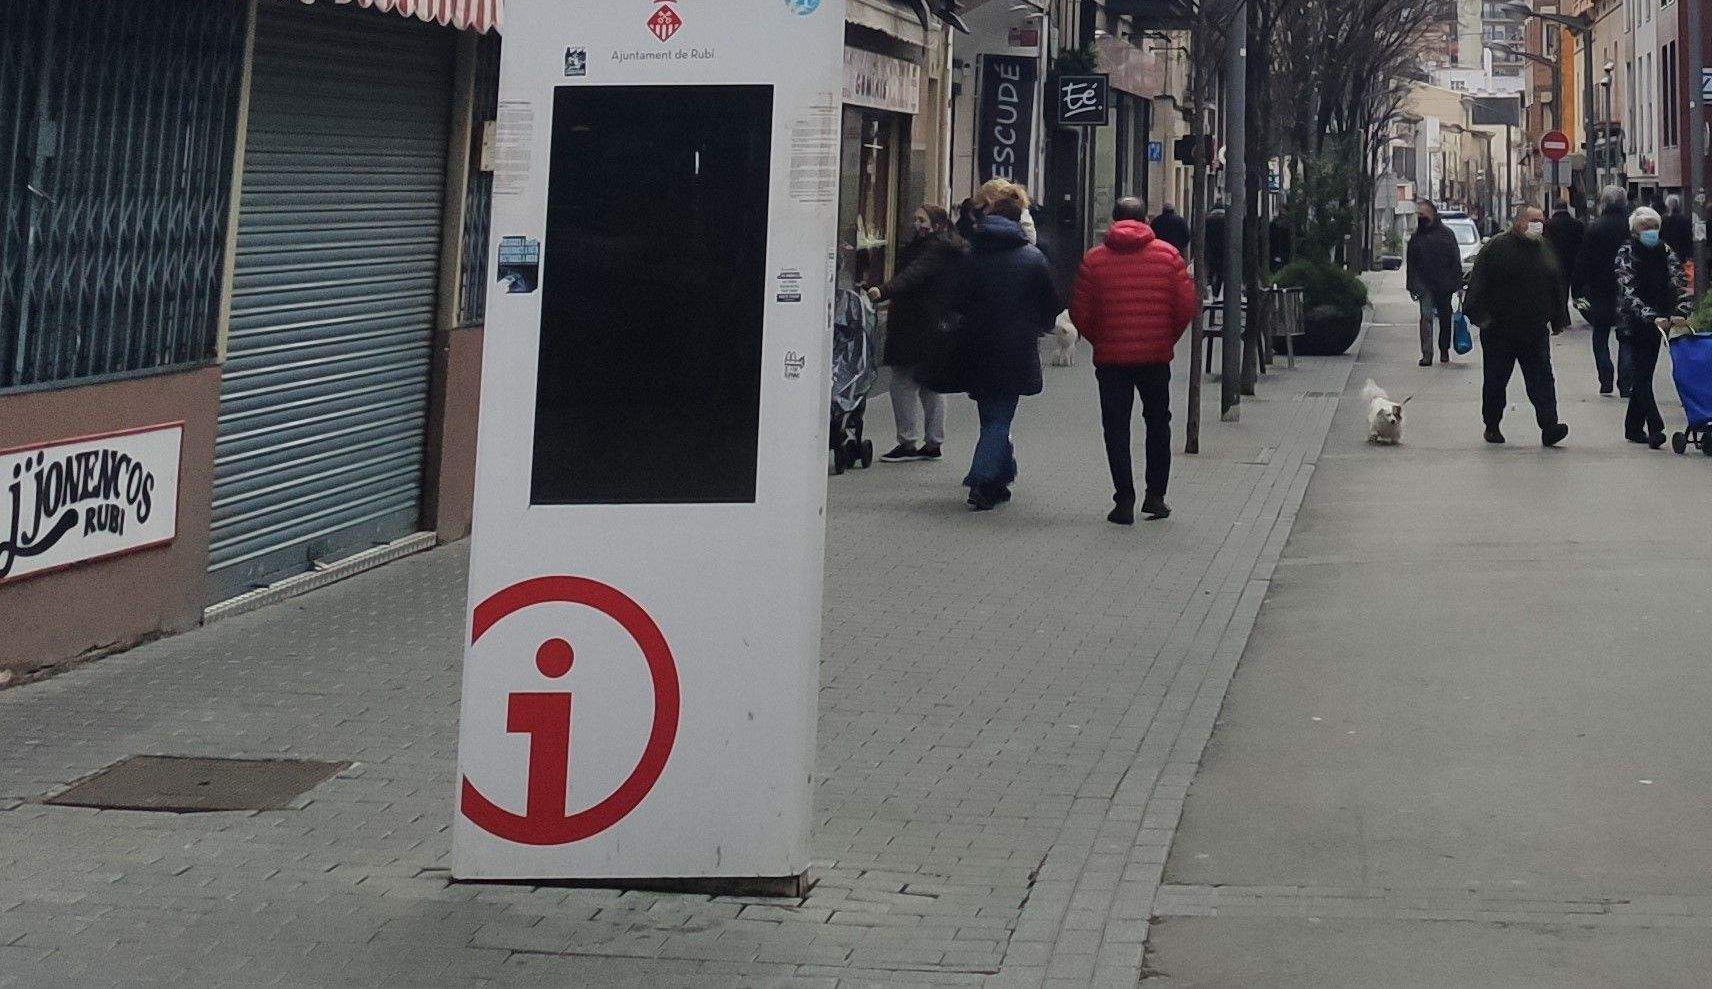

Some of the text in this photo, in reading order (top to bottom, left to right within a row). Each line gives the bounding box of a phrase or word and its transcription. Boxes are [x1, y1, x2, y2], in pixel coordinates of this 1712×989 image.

[612, 50, 671, 63] Ajuntament
[675, 50, 688, 60] de
[992, 61, 1020, 180] ESCUDÉ
